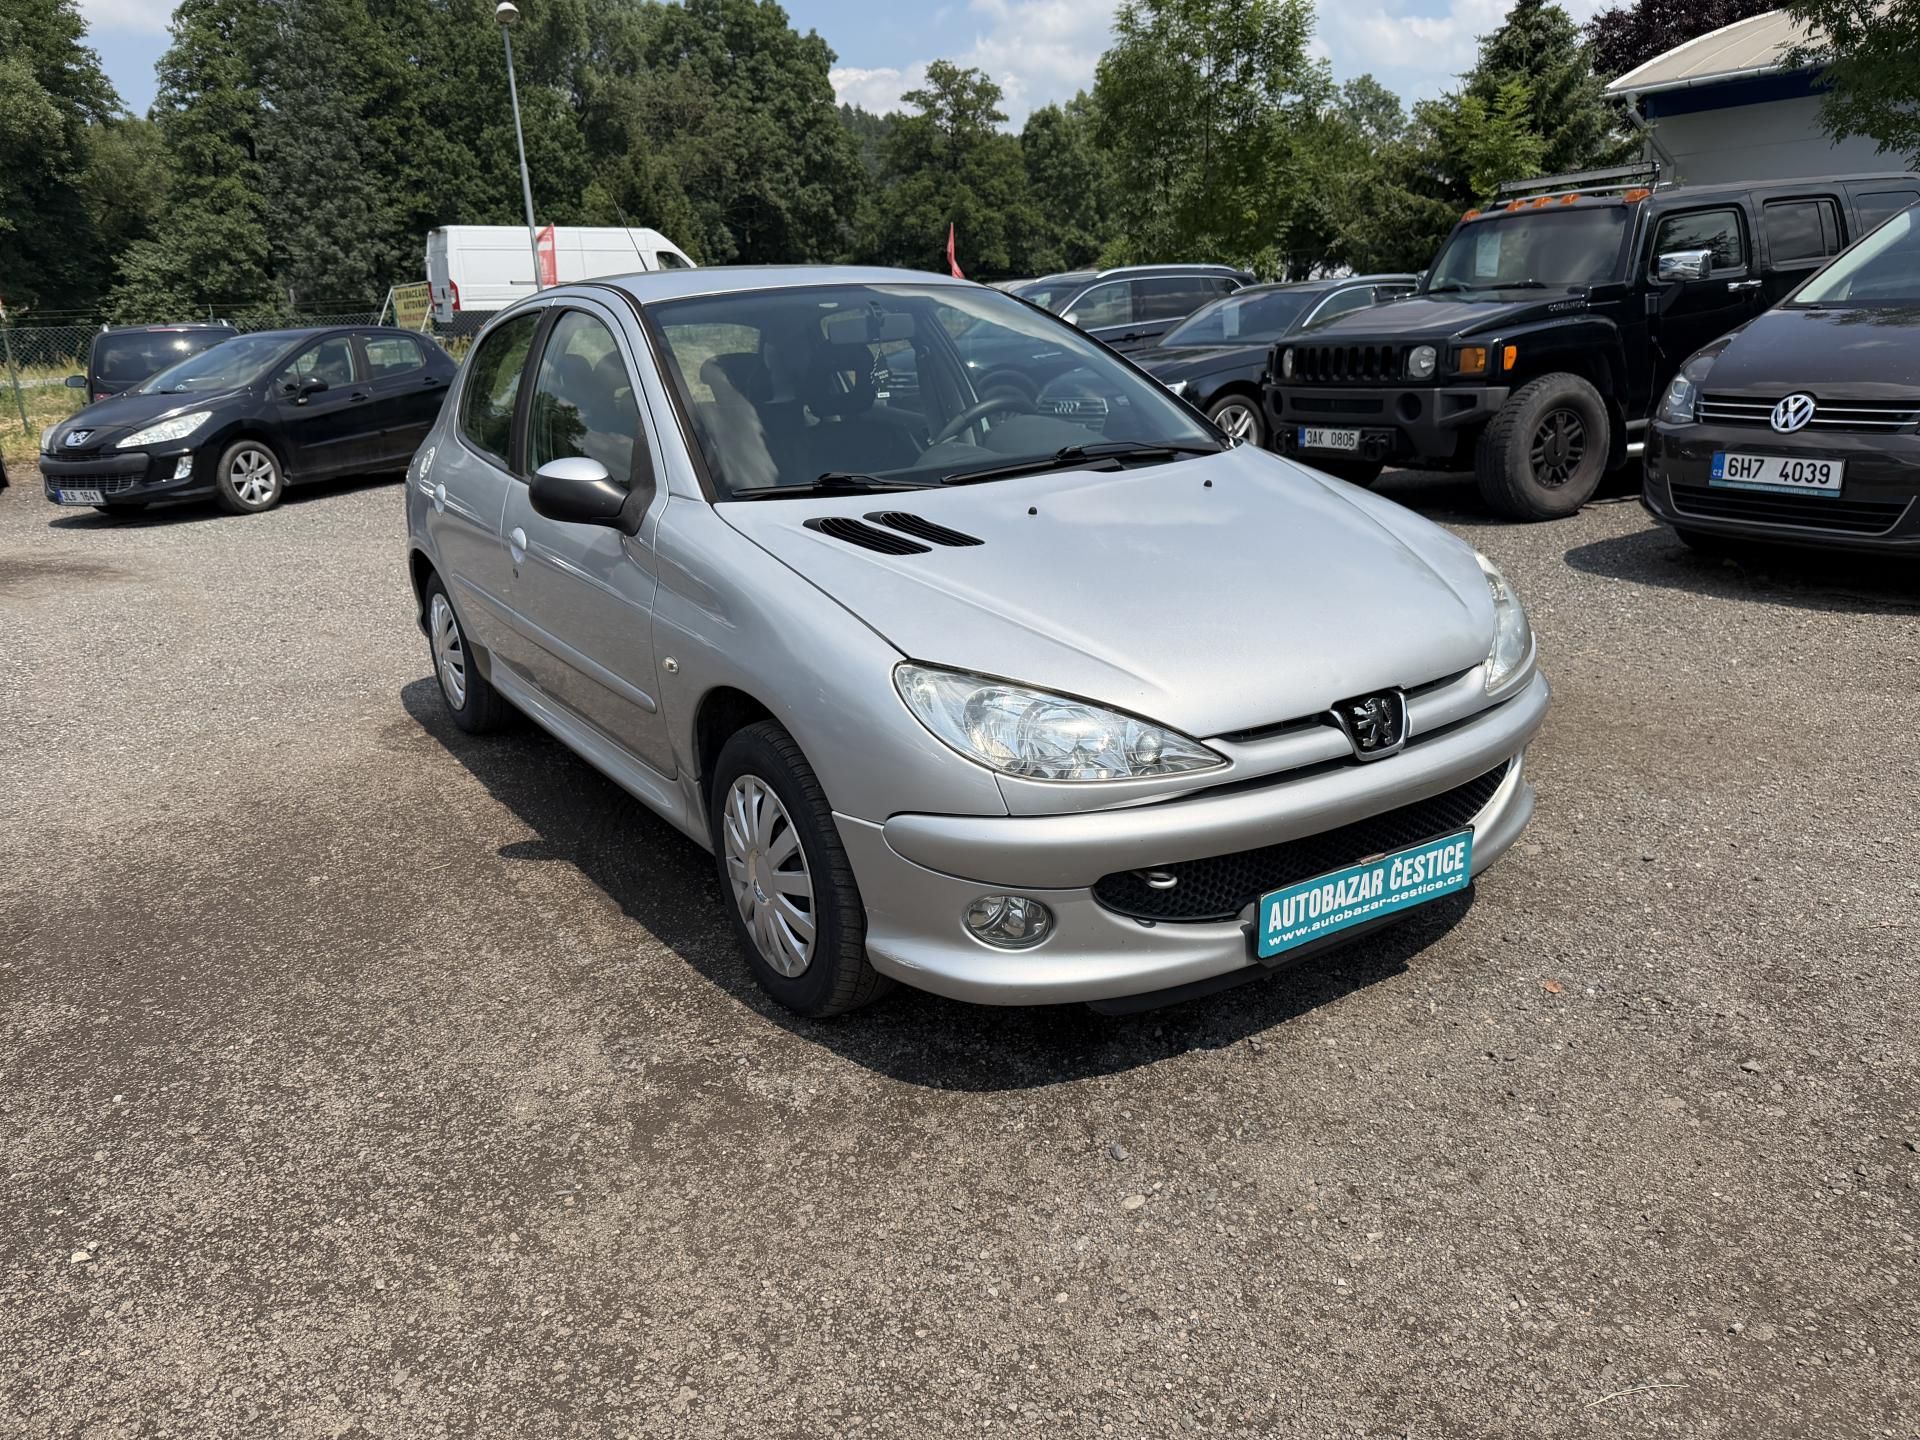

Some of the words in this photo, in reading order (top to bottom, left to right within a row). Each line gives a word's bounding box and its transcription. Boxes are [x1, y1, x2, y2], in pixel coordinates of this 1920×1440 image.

[1306, 430, 1324, 446] 3AK
[1330, 431, 1355, 447] 0805
[1728, 457, 1765, 479] 6H7
[1778, 460, 1831, 485] 4039
[1268, 868, 1385, 934] AUTOBAZAR
[1389, 841, 1466, 891] ČESTICE
[1268, 873, 1464, 947] www.autobazar-cestice.cz
